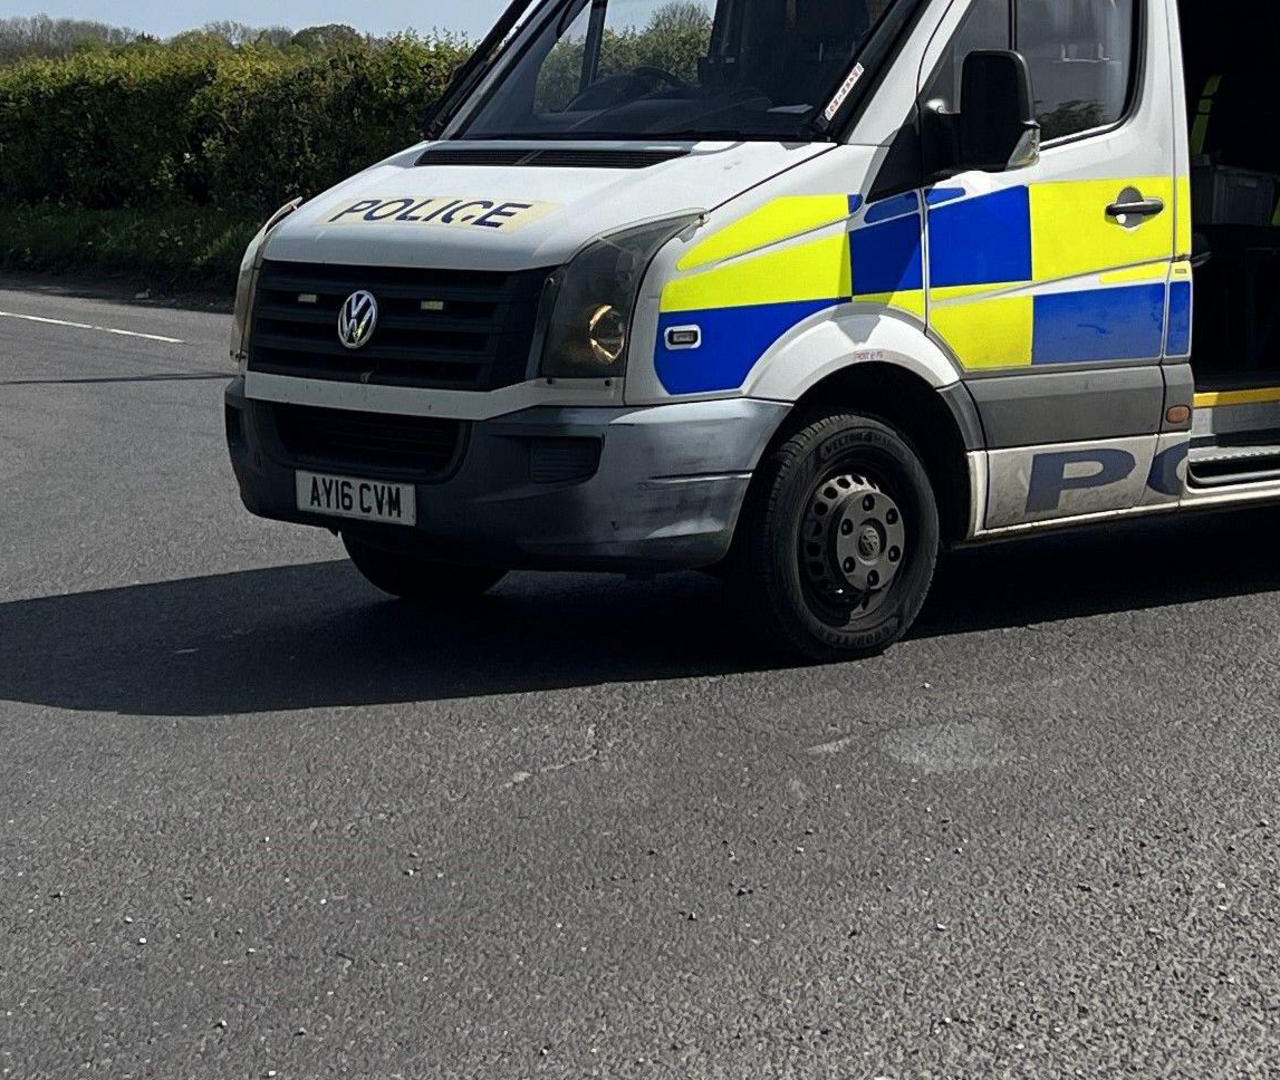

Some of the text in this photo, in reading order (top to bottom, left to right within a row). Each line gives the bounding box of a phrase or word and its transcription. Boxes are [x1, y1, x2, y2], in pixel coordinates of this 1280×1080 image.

[328, 198, 533, 229] POLICE
[310, 476, 401, 518] AY16 CVM
